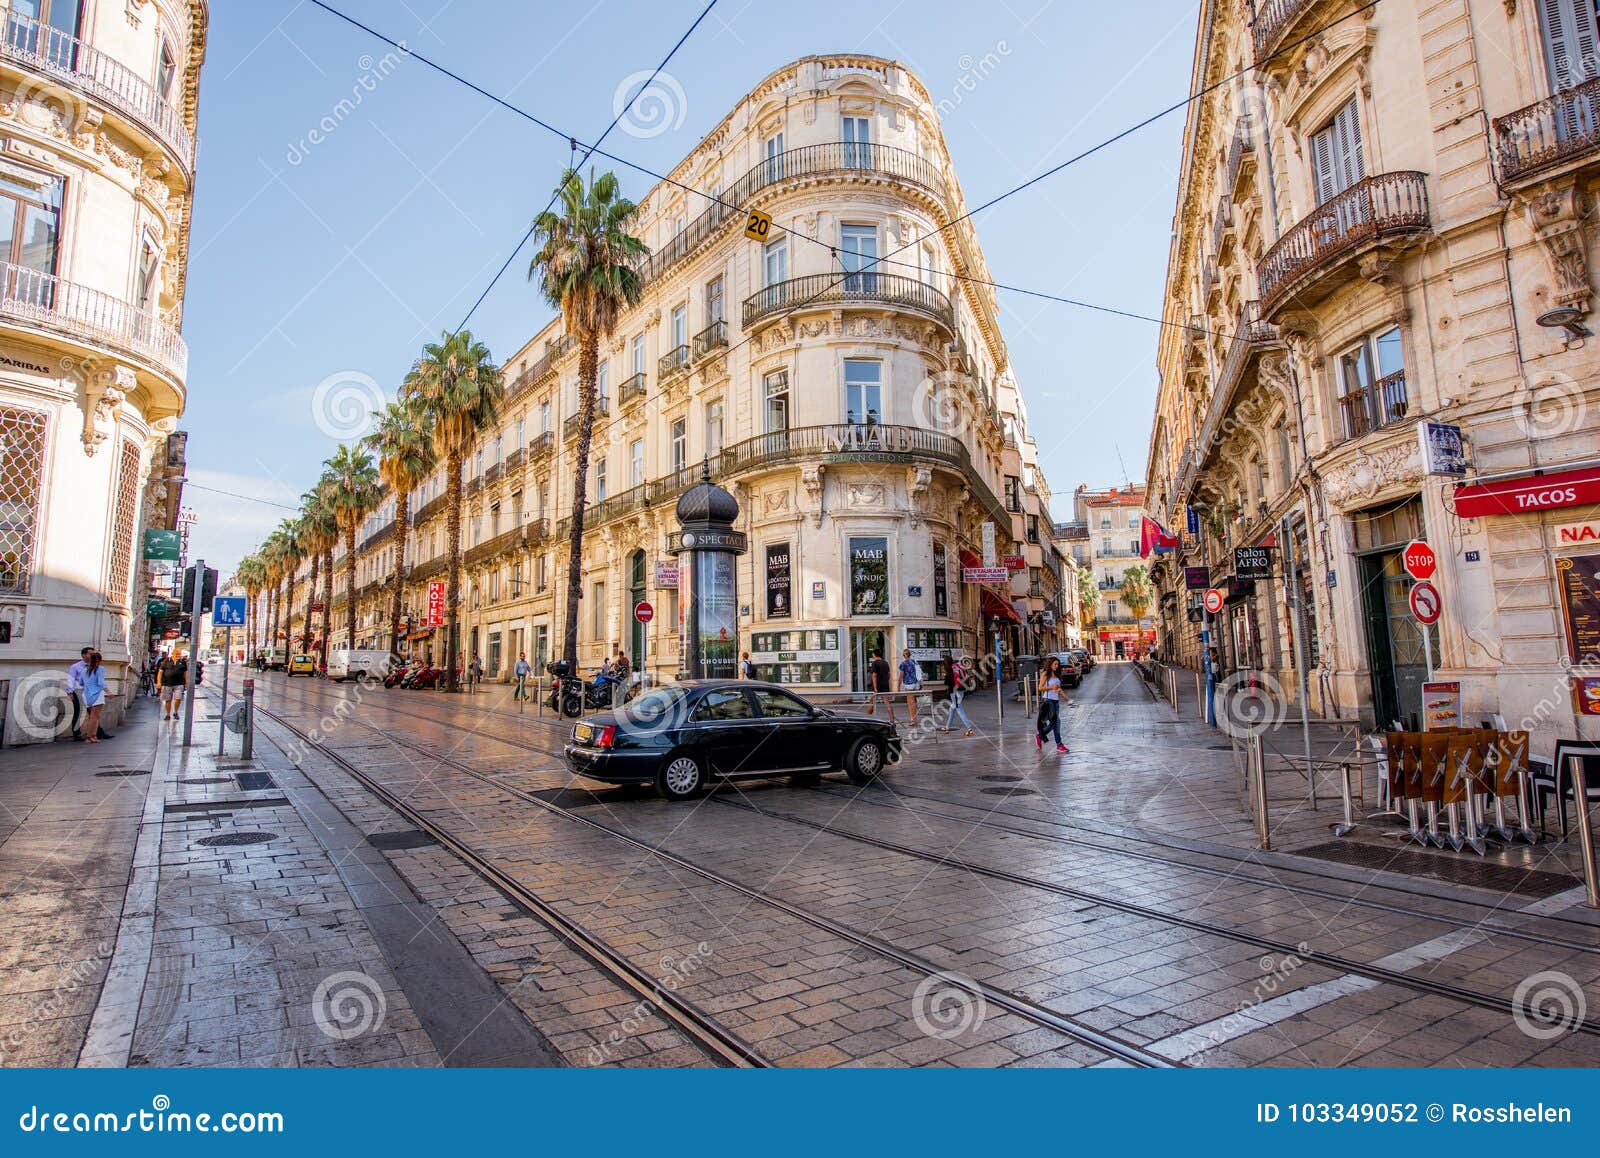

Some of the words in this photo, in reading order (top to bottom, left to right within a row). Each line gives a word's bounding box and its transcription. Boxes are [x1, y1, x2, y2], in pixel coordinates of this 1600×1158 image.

[748, 215, 768, 235] 20
[821, 425, 913, 453] MAB
[1515, 488, 1577, 508] TACOS
[1561, 526, 1600, 542] NA
[769, 554, 788, 566] MAB
[855, 549, 883, 558] MAB
[1237, 548, 1266, 558] Salon
[1237, 557, 1268, 568] AFRO
[1408, 556, 1433, 567] STOP
[430, 583, 439, 624] HOTEL
